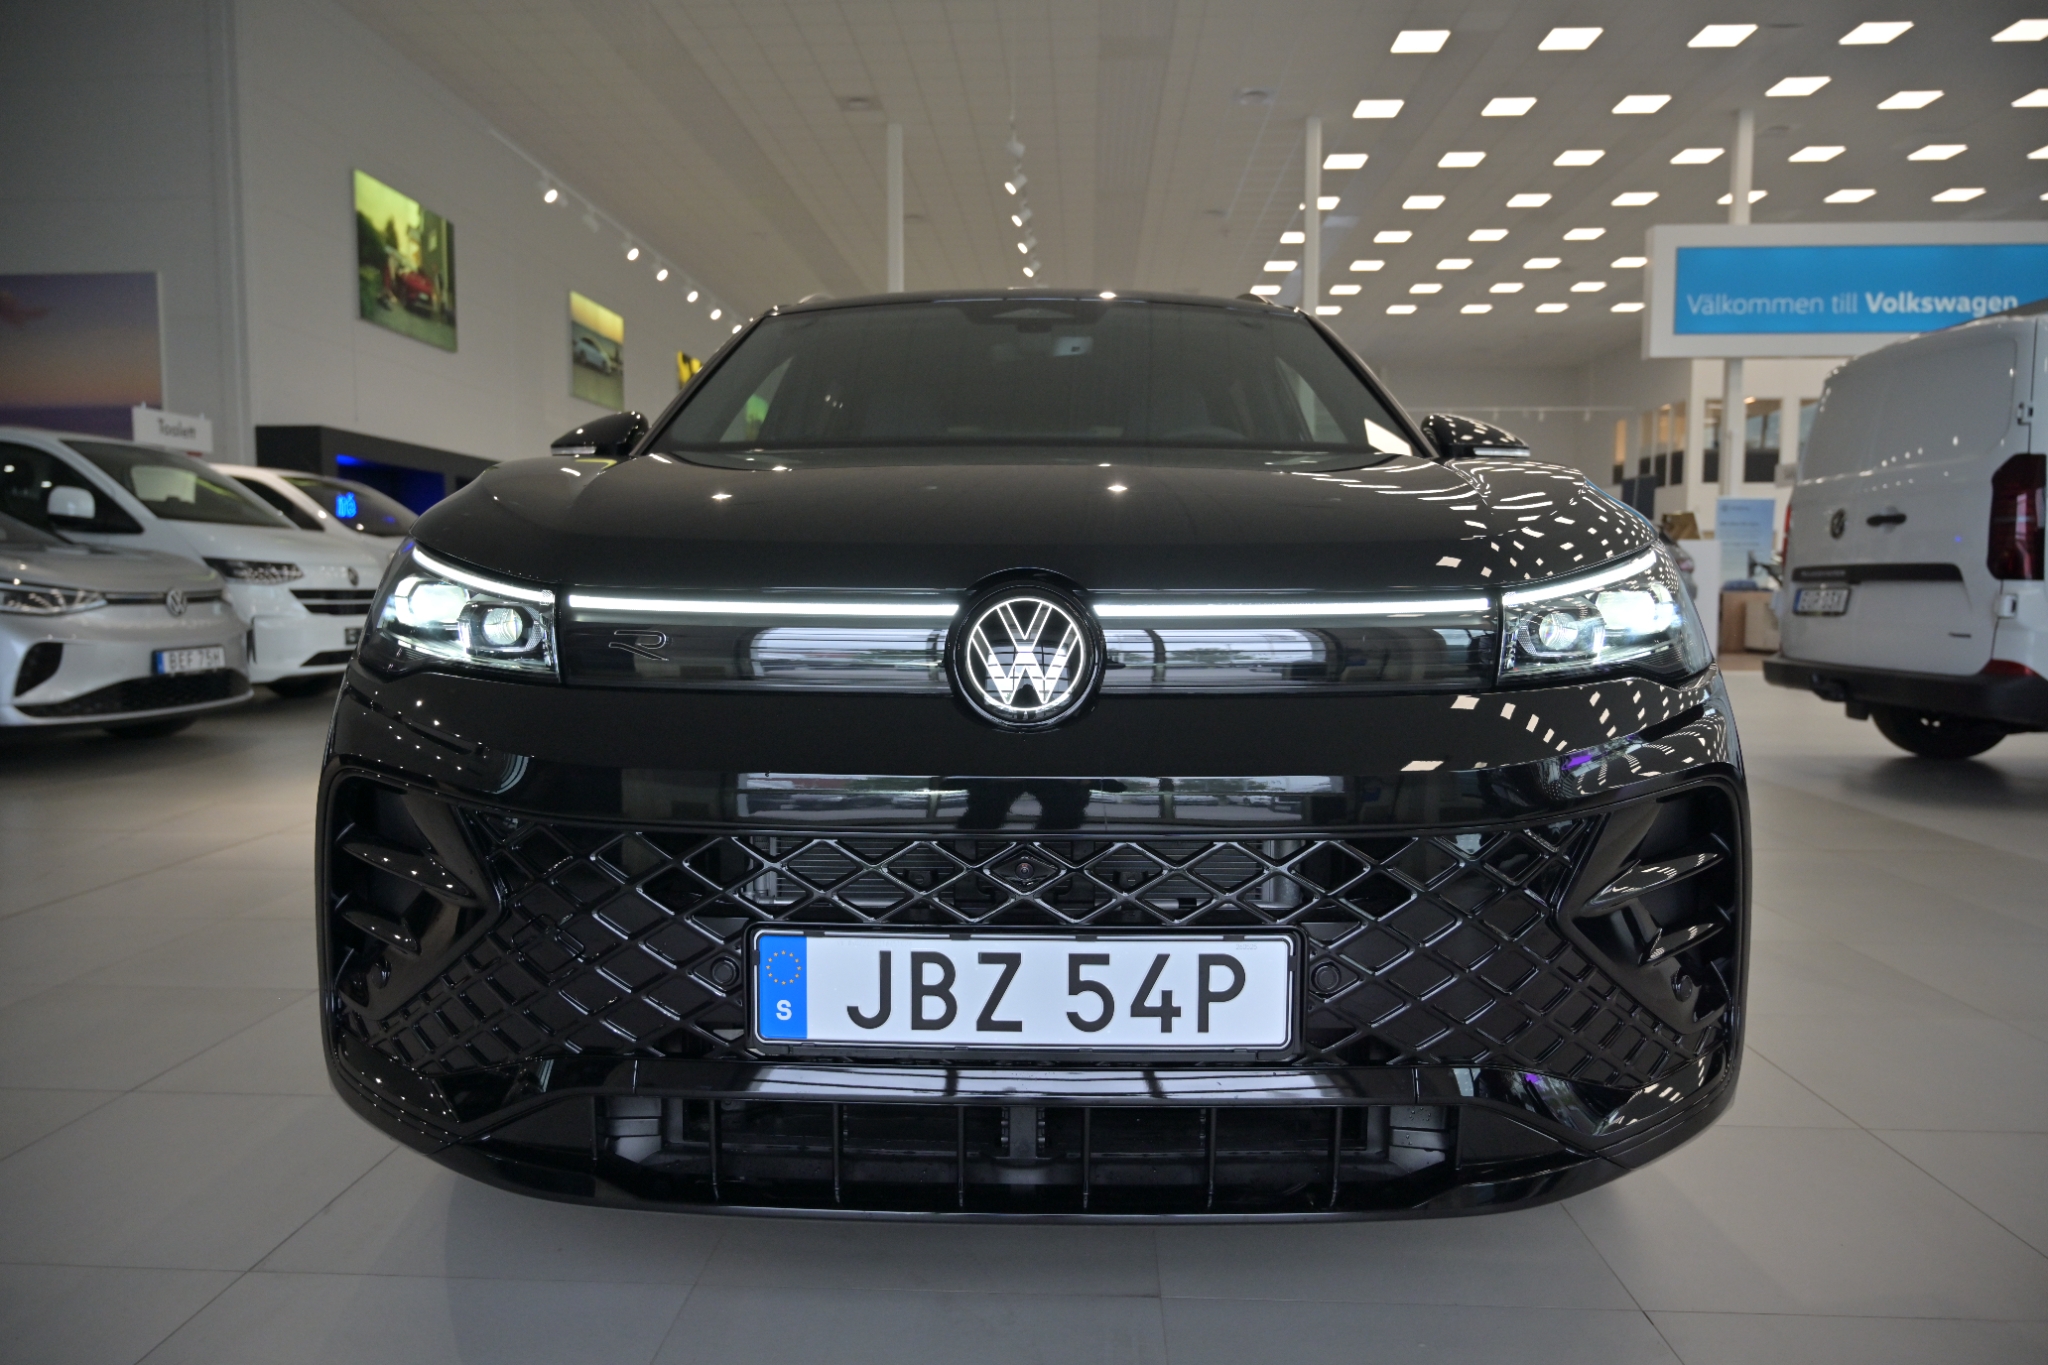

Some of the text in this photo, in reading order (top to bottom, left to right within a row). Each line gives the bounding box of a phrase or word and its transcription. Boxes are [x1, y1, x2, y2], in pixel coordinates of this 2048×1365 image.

[1686, 291, 2019, 318] Välkommen till Volkswagen
[847, 950, 1246, 1033] JBZ 54P
[776, 999, 792, 1021] S
